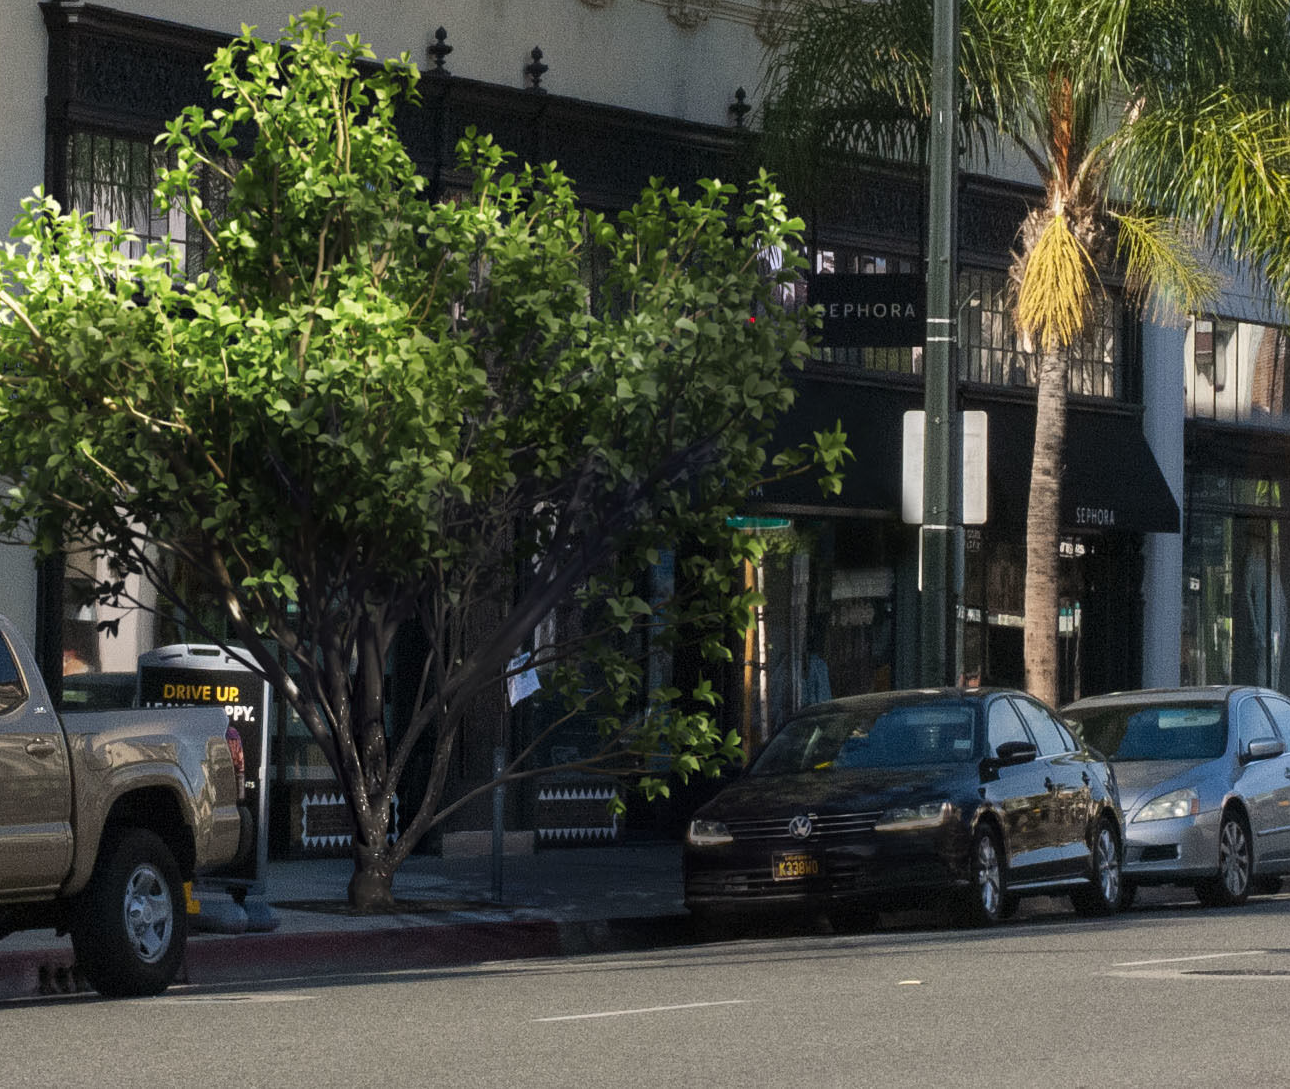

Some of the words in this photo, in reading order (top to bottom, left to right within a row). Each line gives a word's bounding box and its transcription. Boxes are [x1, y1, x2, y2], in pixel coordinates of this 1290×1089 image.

[1076, 507, 1115, 525] SEPHORA
[164, 684, 211, 700] DRIVE
[216, 686, 240, 702] UP.
